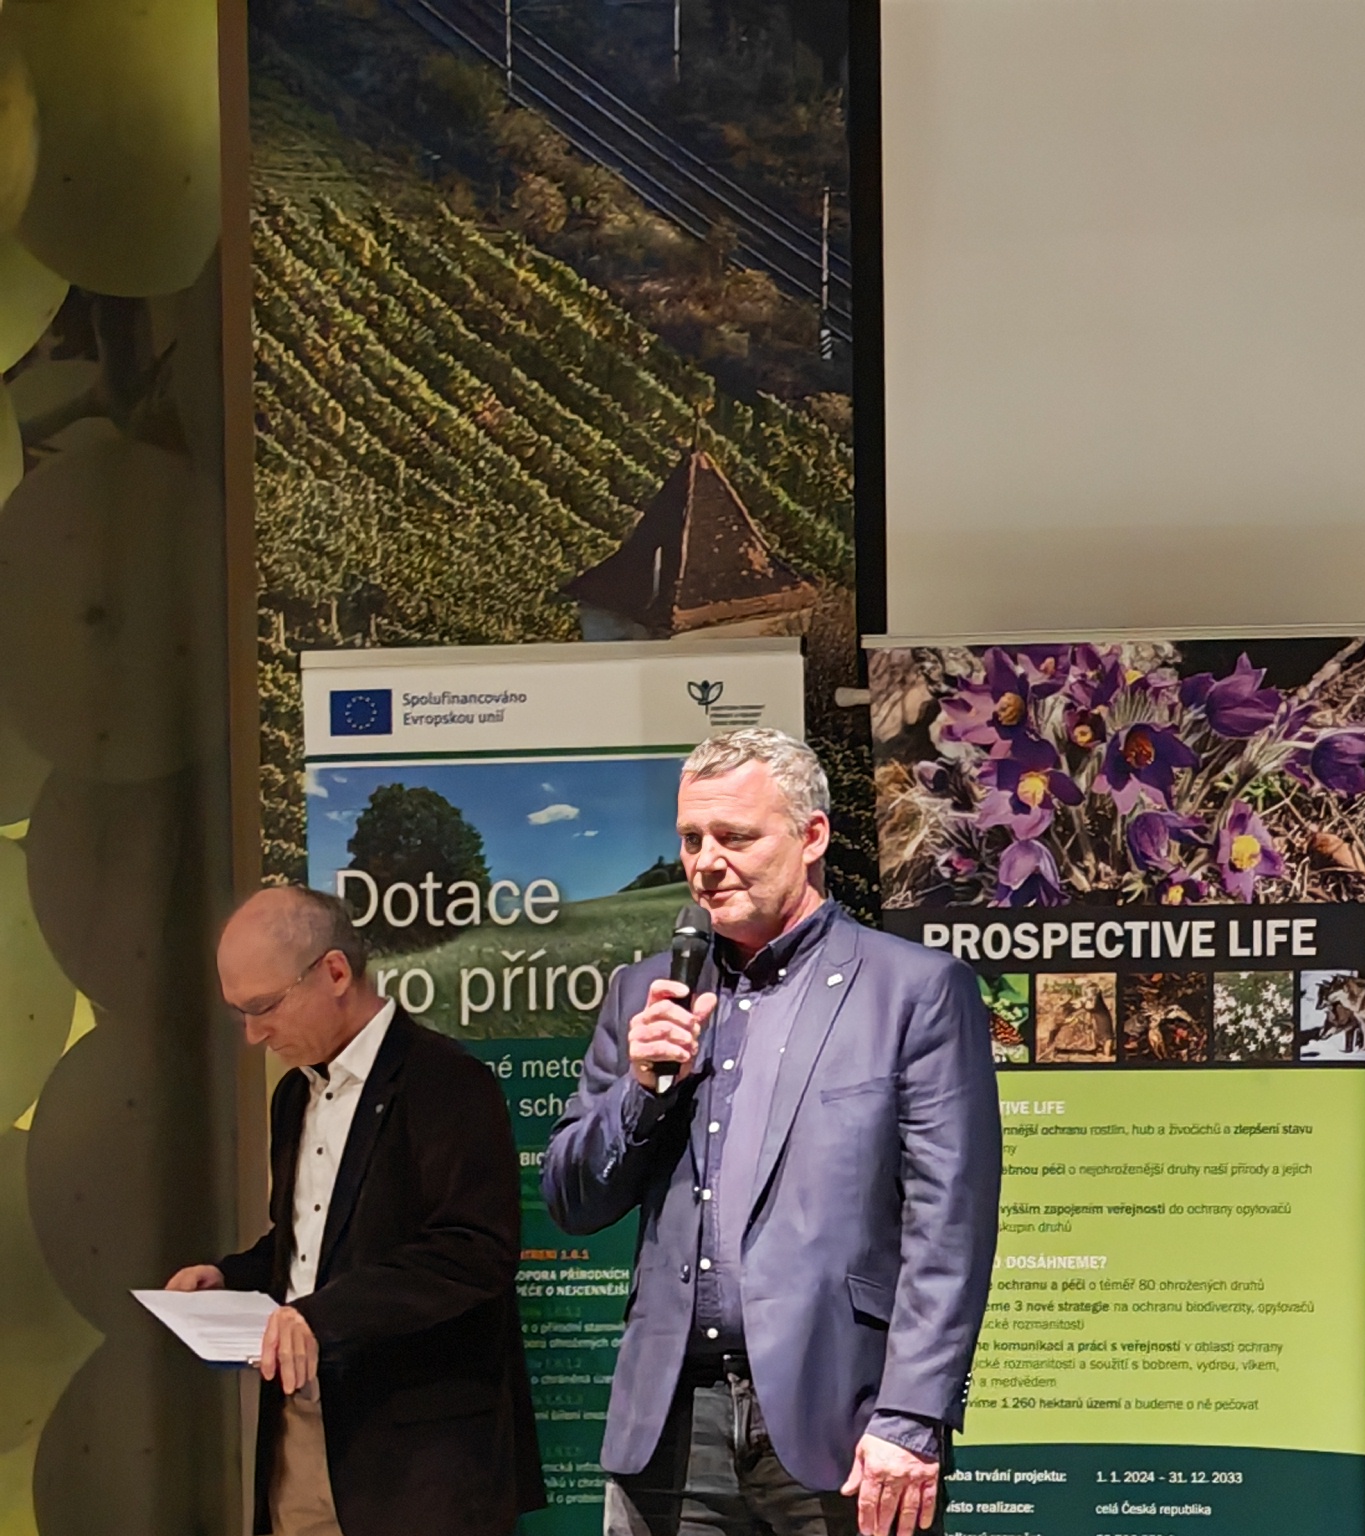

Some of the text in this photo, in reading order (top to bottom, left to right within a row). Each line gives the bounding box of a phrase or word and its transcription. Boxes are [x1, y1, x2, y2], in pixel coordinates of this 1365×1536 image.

[402, 691, 527, 707] Spolufinancováno
[403, 711, 474, 727] Evropskou
[336, 870, 560, 928] Dotace
[923, 919, 1317, 960] PROSPECTIVE LIFE
[377, 950, 643, 1026] ro příro
[522, 1057, 582, 1078] meto
[1034, 1101, 1065, 1115] LIFE
[1282, 1124, 1313, 1135] stavu
[1006, 1255, 1107, 1269] DOSÁHNEME?
[944, 1470, 1067, 1484] oba trvání projektu:
[1124, 1472, 1155, 1483] 2024
[1212, 1473, 1243, 1484] 2033
[976, 1500, 1035, 1513] realizace:
[1096, 1500, 1211, 1517] celá Česká republika
